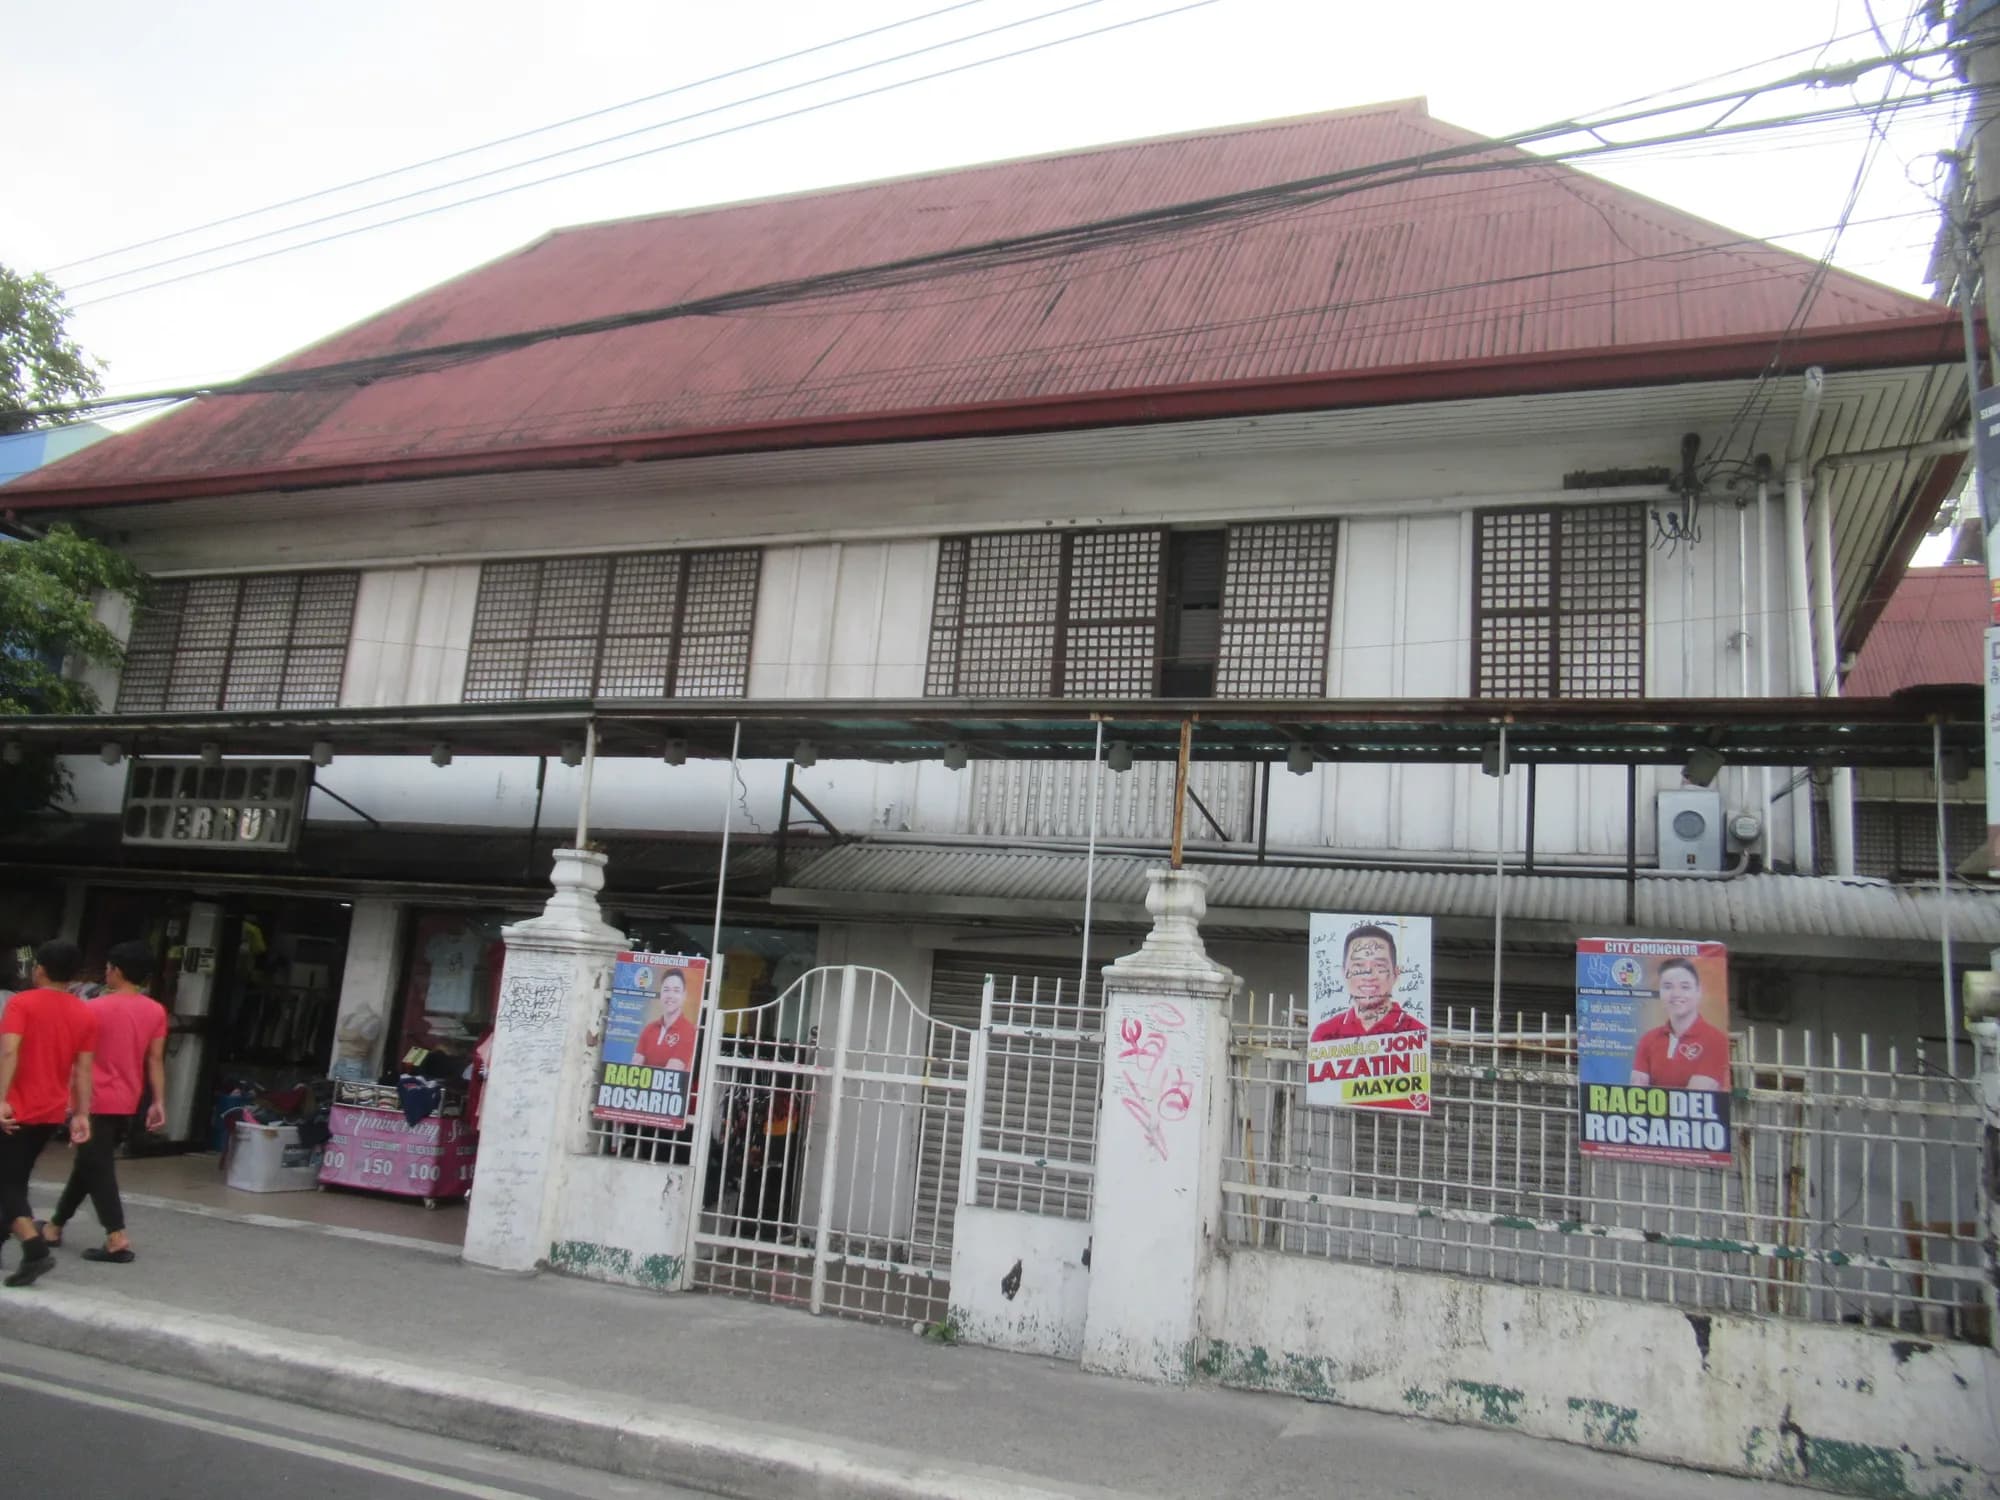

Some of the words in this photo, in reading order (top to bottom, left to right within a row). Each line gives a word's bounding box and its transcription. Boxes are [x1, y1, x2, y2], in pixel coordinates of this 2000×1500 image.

[125, 804, 290, 842] OVERRUN
[632, 953, 650, 963] CITY
[1604, 941, 1631, 953] CITY
[1632, 943, 1698, 956] COUNCILOR
[1308, 1040, 1380, 1061] CARMELO
[604, 1063, 652, 1089] RACO
[652, 1069, 681, 1093] DEL
[1308, 1053, 1411, 1083] LAZATIN
[598, 1084, 683, 1116] ROSARIO
[1352, 1076, 1423, 1097] MAYOR
[1589, 1085, 1667, 1117] RACO
[1668, 1090, 1719, 1120] DEL
[1585, 1113, 1726, 1151] ROSARIO
[363, 1158, 393, 1176] 150
[409, 1163, 439, 1181] 100
